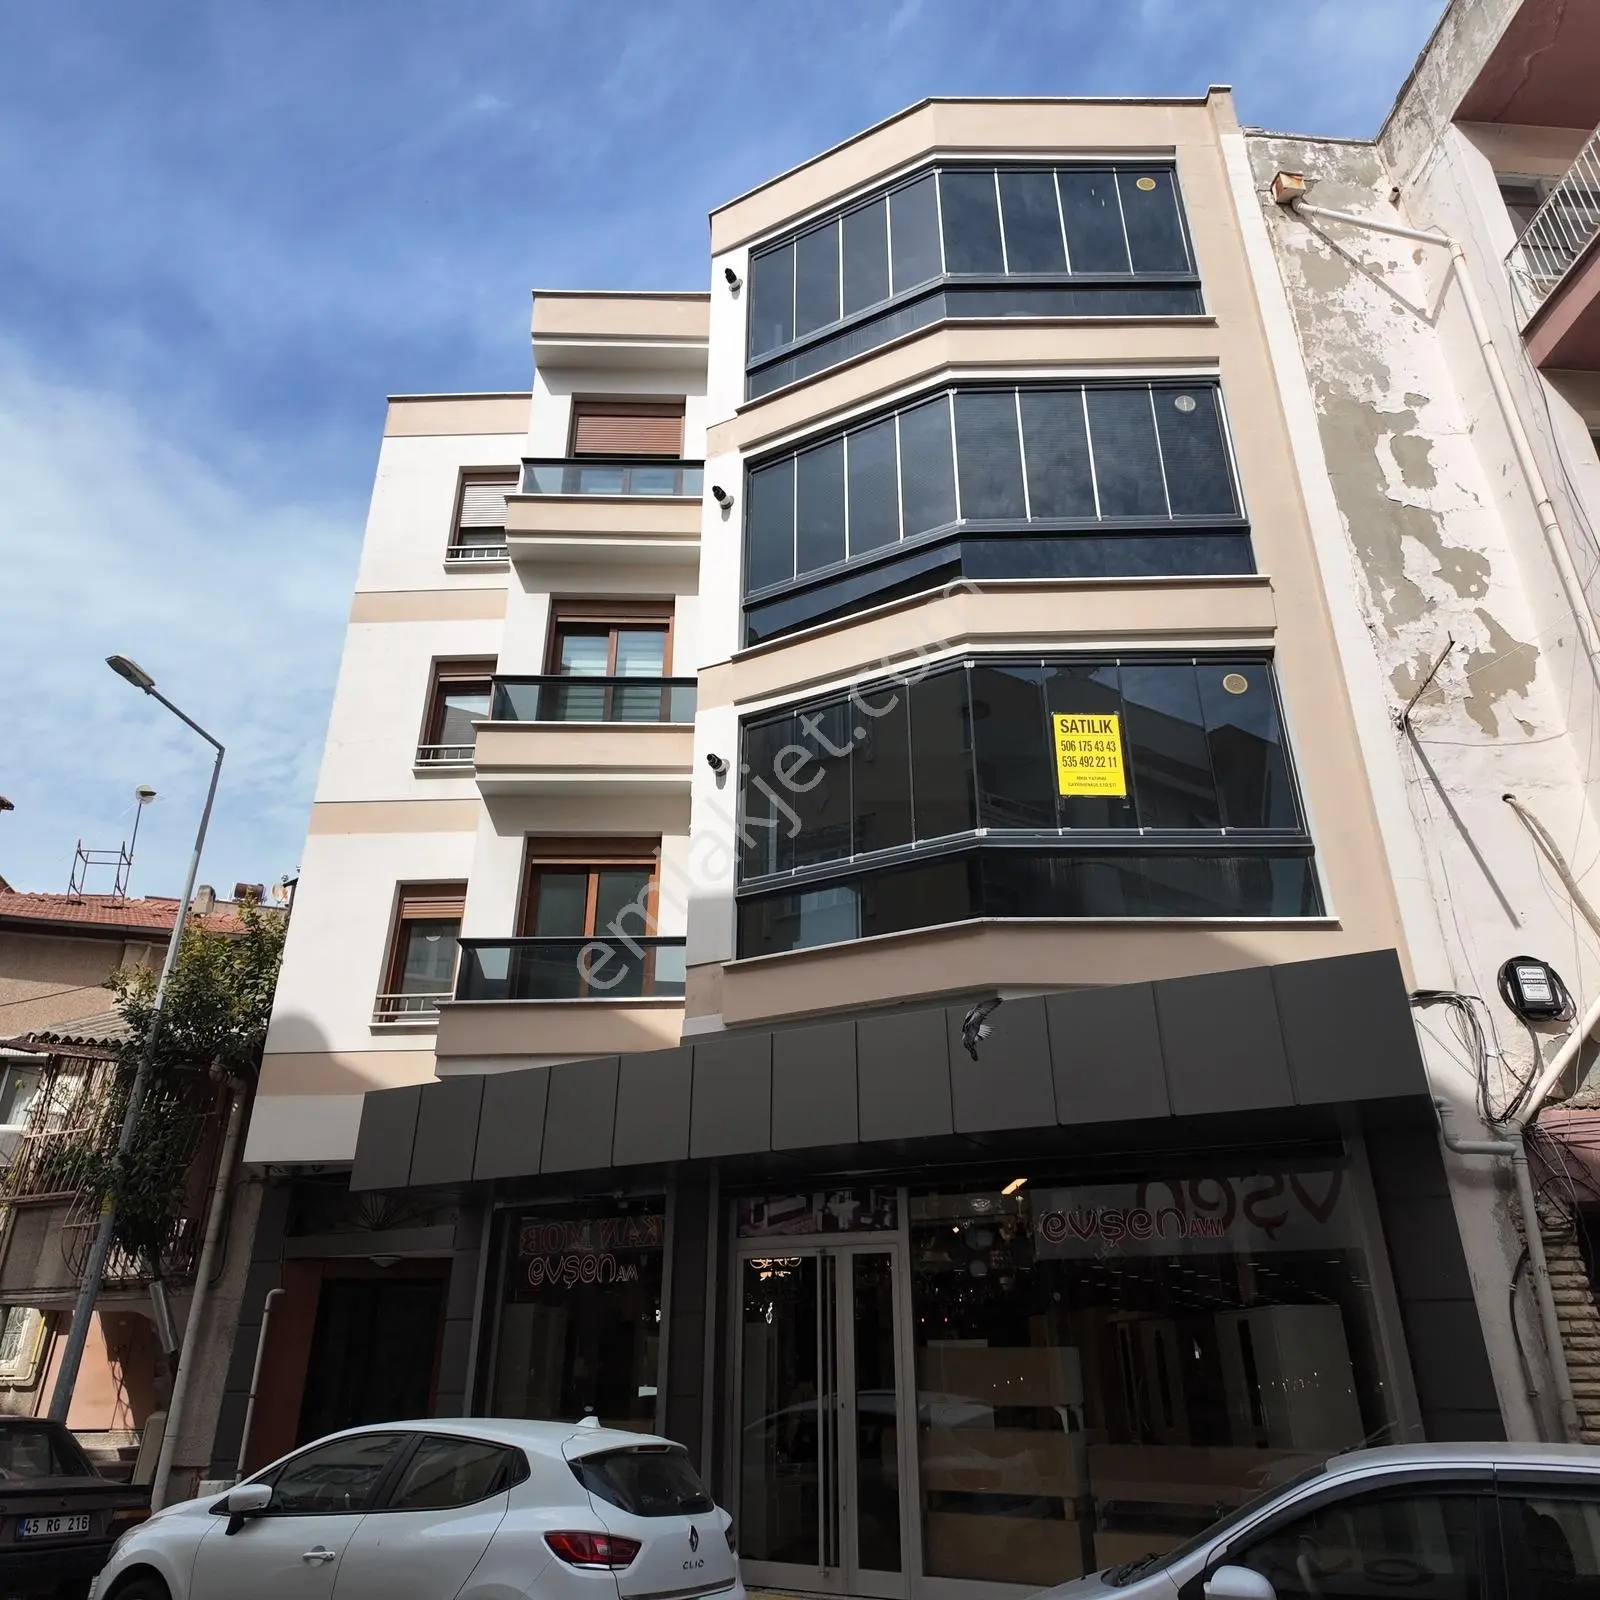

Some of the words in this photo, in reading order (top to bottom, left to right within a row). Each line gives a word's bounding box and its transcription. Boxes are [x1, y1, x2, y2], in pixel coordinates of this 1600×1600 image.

[1060, 718, 1113, 734] SATILIK
[1060, 740, 1076, 752] 506
[1079, 740, 1092, 752] 175
[1094, 740, 1104, 752] 43
[1106, 740, 1116, 752] 43
[1062, 755, 1077, 768] 535
[1079, 755, 1094, 768] 492
[1095, 756, 1106, 768] 22
[1108, 756, 1117, 768] 11
[1040, 1207, 1188, 1247] evşen
[1188, 1215, 1225, 1239] AVM
[528, 1253, 617, 1289] evşen
[25, 1519, 40, 1534] 45
[46, 1518, 60, 1532] RG
[68, 1516, 88, 1531] 216
[682, 1559, 705, 1570] CLIO
